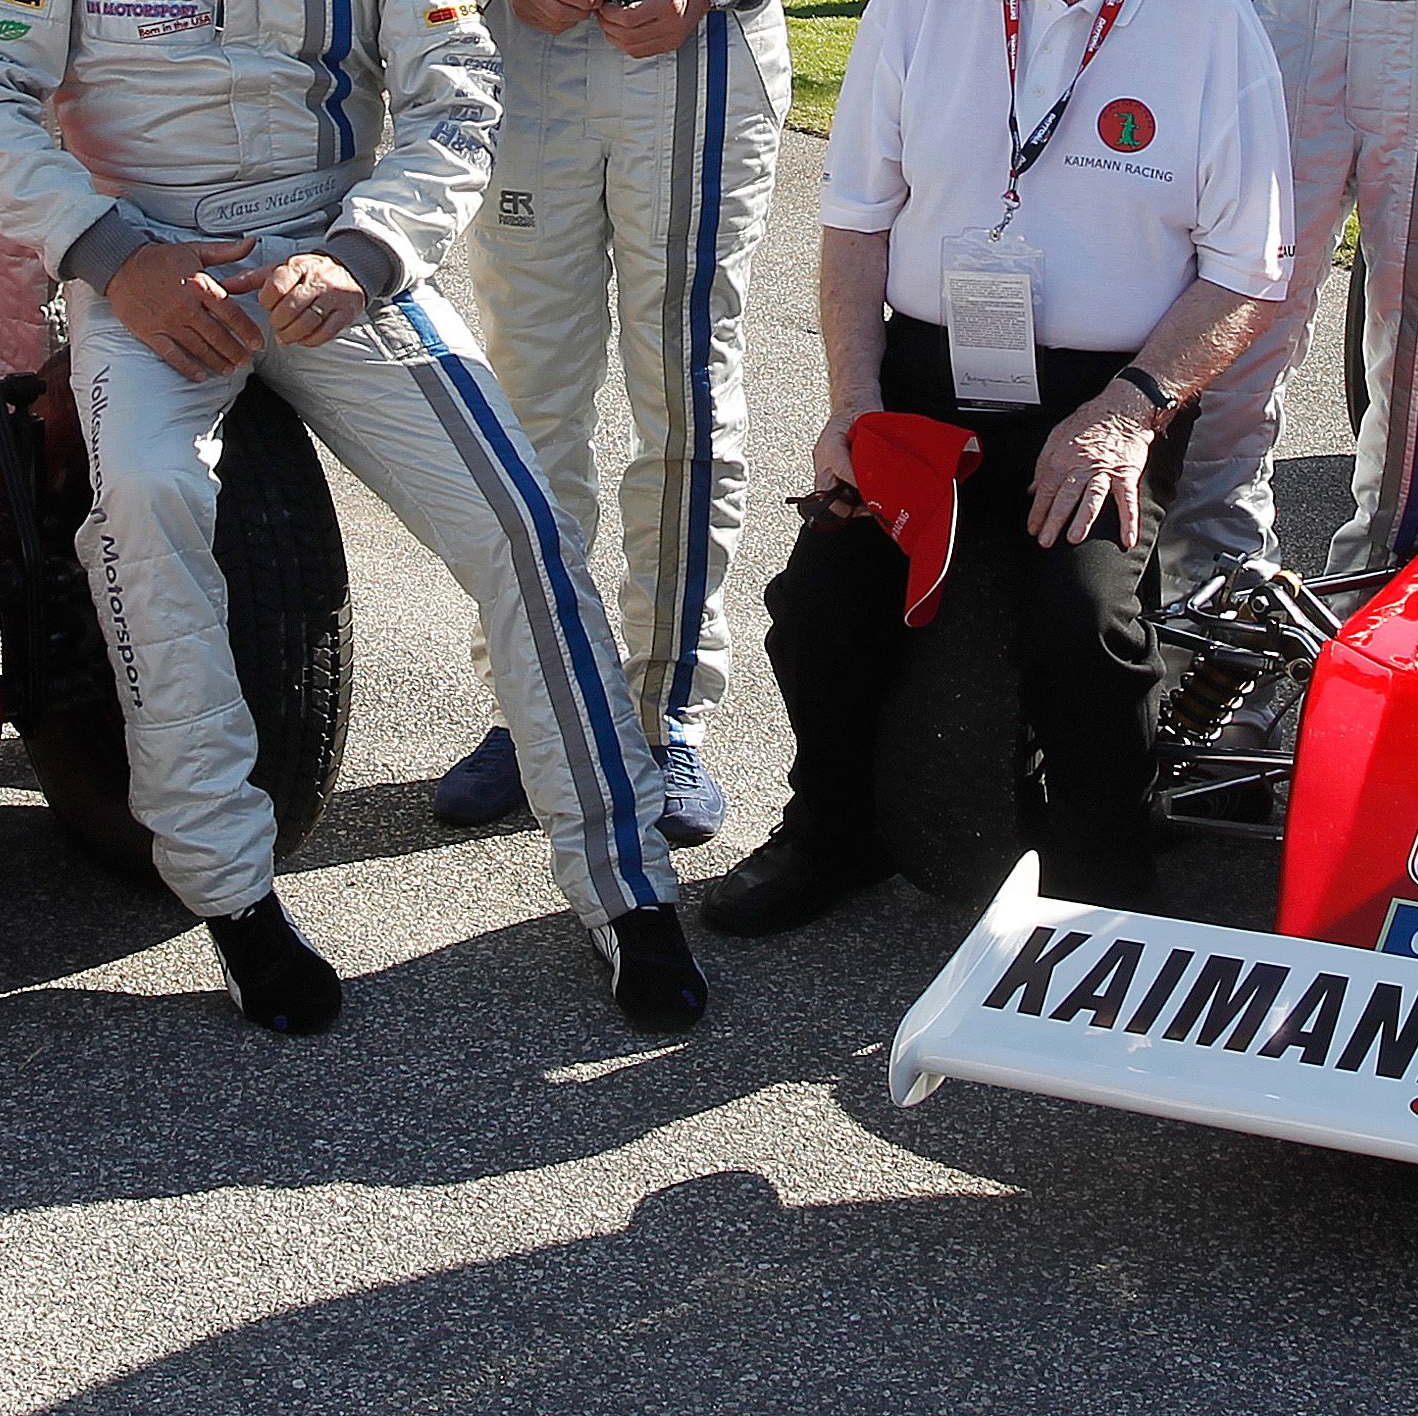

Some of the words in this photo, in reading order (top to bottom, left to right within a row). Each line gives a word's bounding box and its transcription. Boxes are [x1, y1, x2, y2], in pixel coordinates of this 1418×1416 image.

[103, 2, 199, 18] MOTORSPORT
[139, 26, 161, 37] Born
[161, 22, 173, 32] in
[174, 19, 190, 30] the
[191, 14, 211, 27] USA
[1064, 155, 1122, 172] KAIMANN
[1125, 162, 1174, 183] RACING
[217, 201, 260, 220] Klaus
[100, 534, 144, 711] Motorsport
